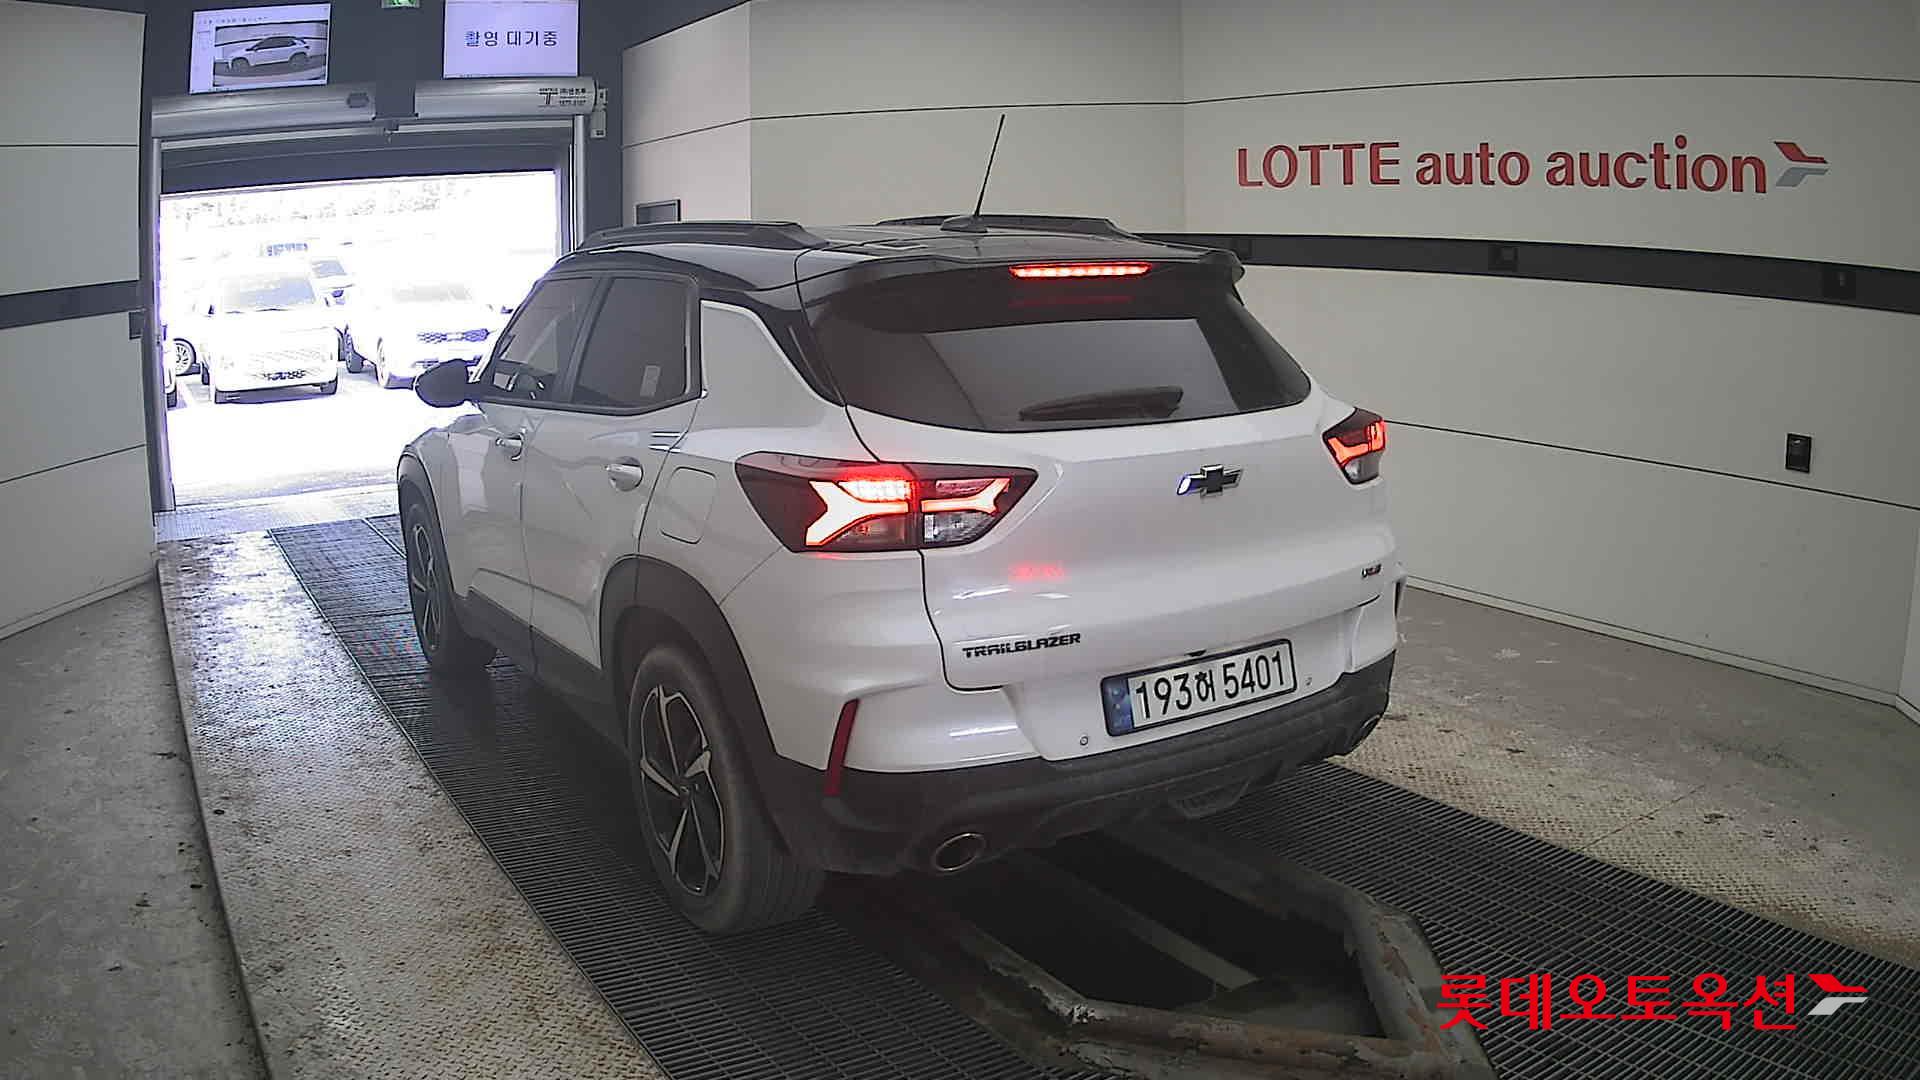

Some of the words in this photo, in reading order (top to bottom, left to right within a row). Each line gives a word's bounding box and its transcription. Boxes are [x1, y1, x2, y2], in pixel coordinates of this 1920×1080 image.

[506, 30, 558, 47] 대기중
[1237, 141, 1400, 188] LOTTE
[1415, 142, 1530, 188] auto
[1545, 134, 1767, 195] auction
[962, 633, 1081, 658] TRAILBLAZER
[1222, 650, 1285, 699] 5401
